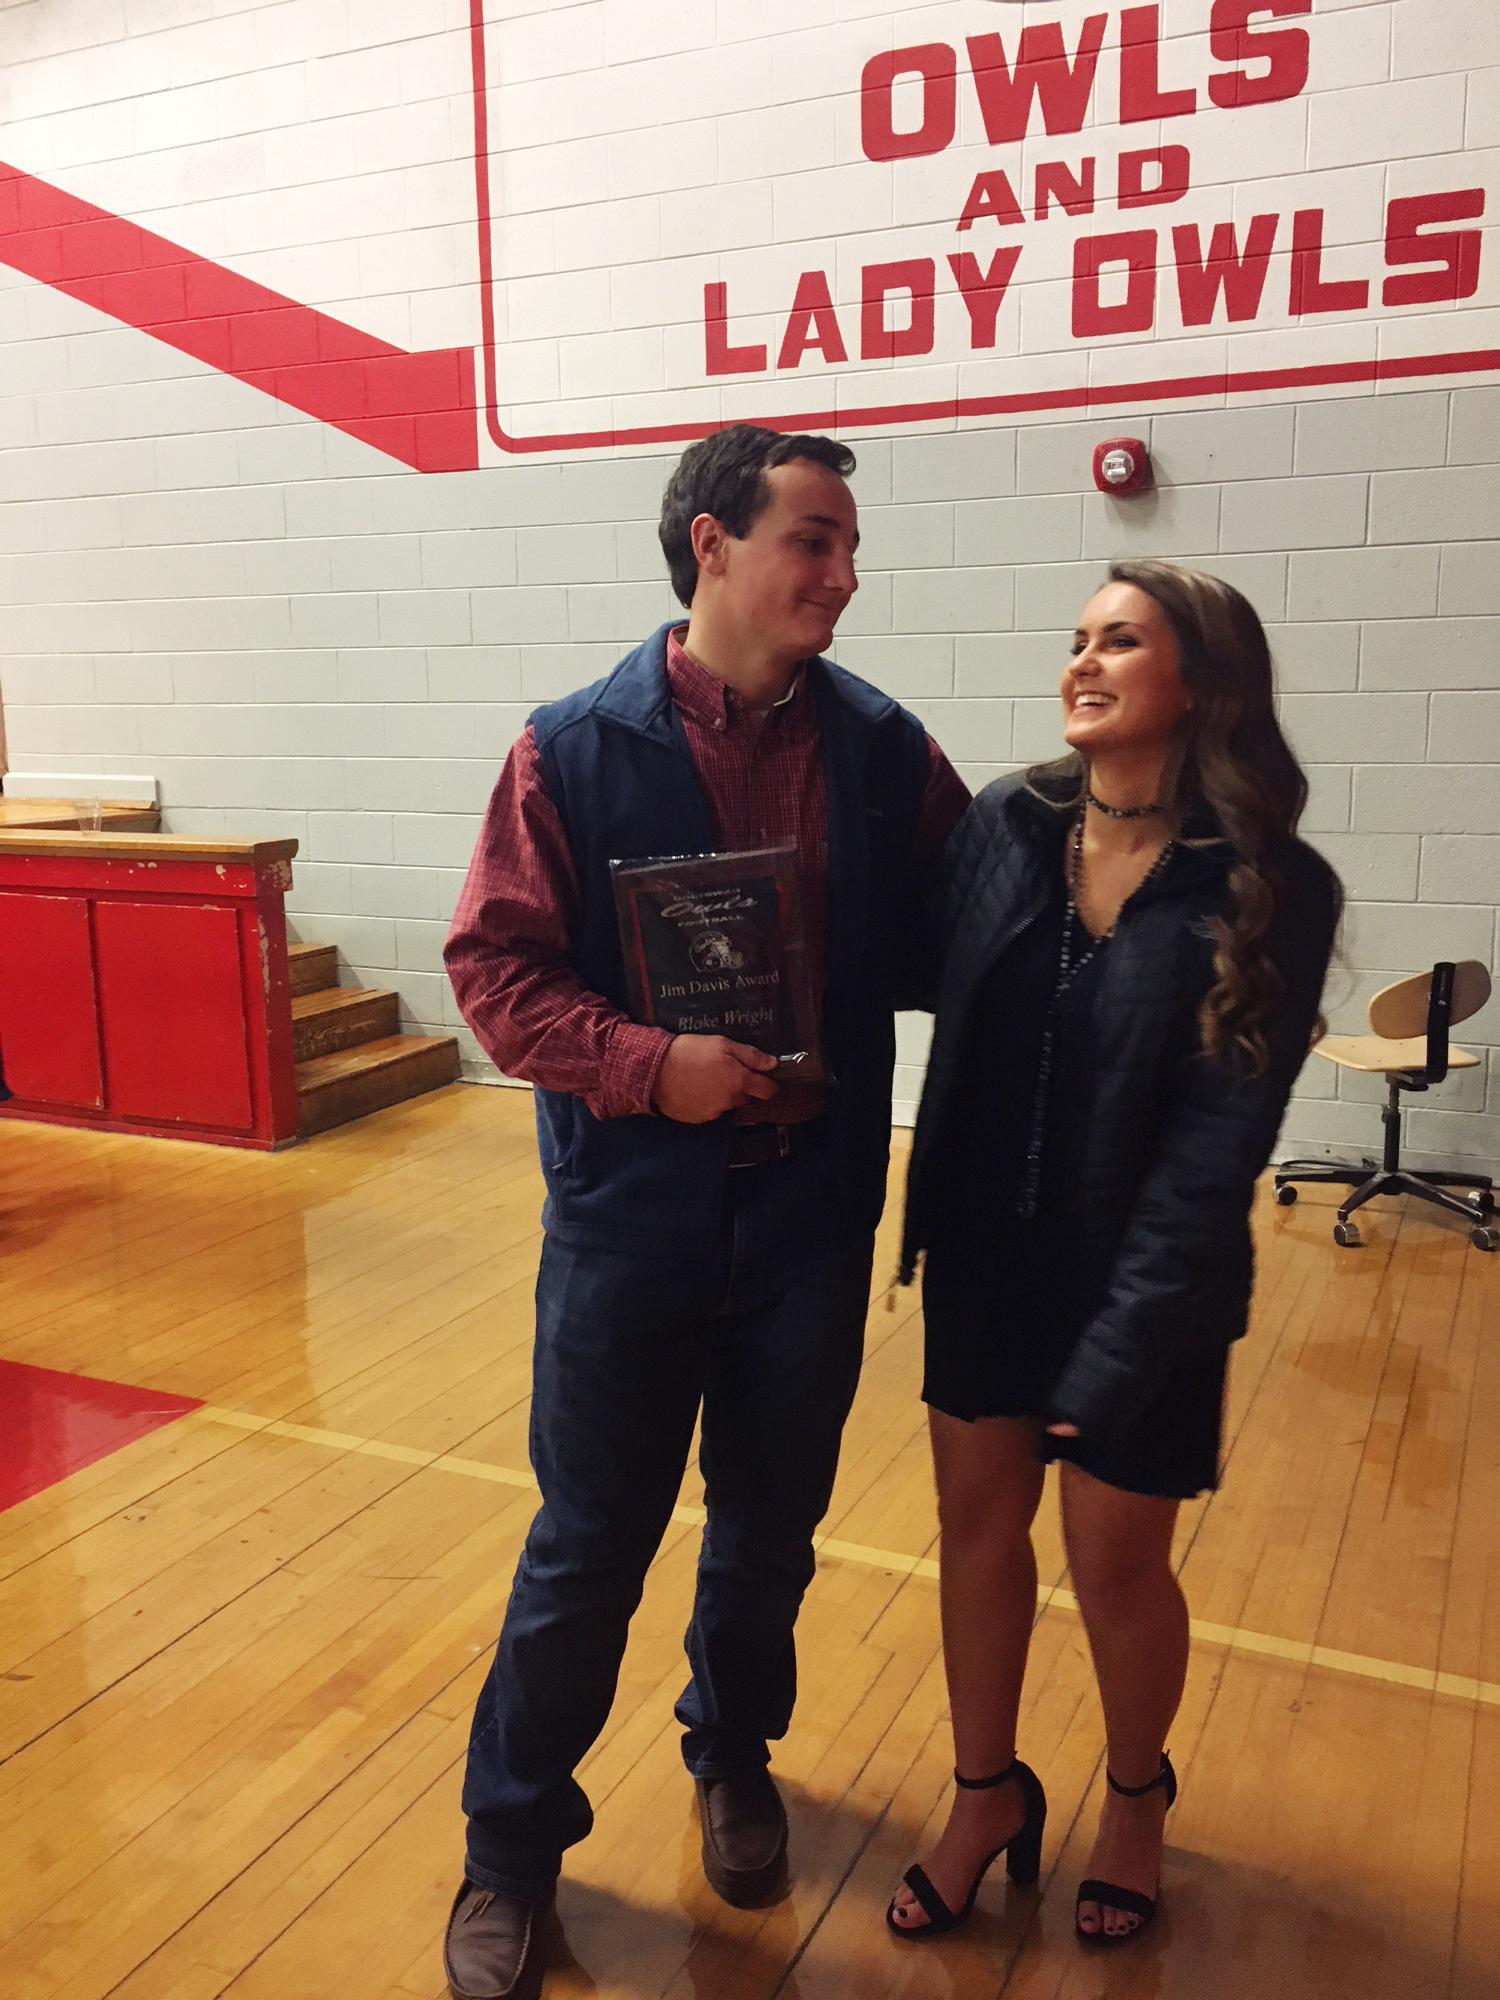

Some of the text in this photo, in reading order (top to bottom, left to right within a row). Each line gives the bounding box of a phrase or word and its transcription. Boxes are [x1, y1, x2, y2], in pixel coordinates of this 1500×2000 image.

[862, 0, 1312, 162] OWLS
[958, 146, 1190, 231] AND
[705, 189, 1484, 376] LADY OWLS
[660, 969, 780, 998] Jim Davis Award
[678, 1007, 774, 1031] Blake Wright
